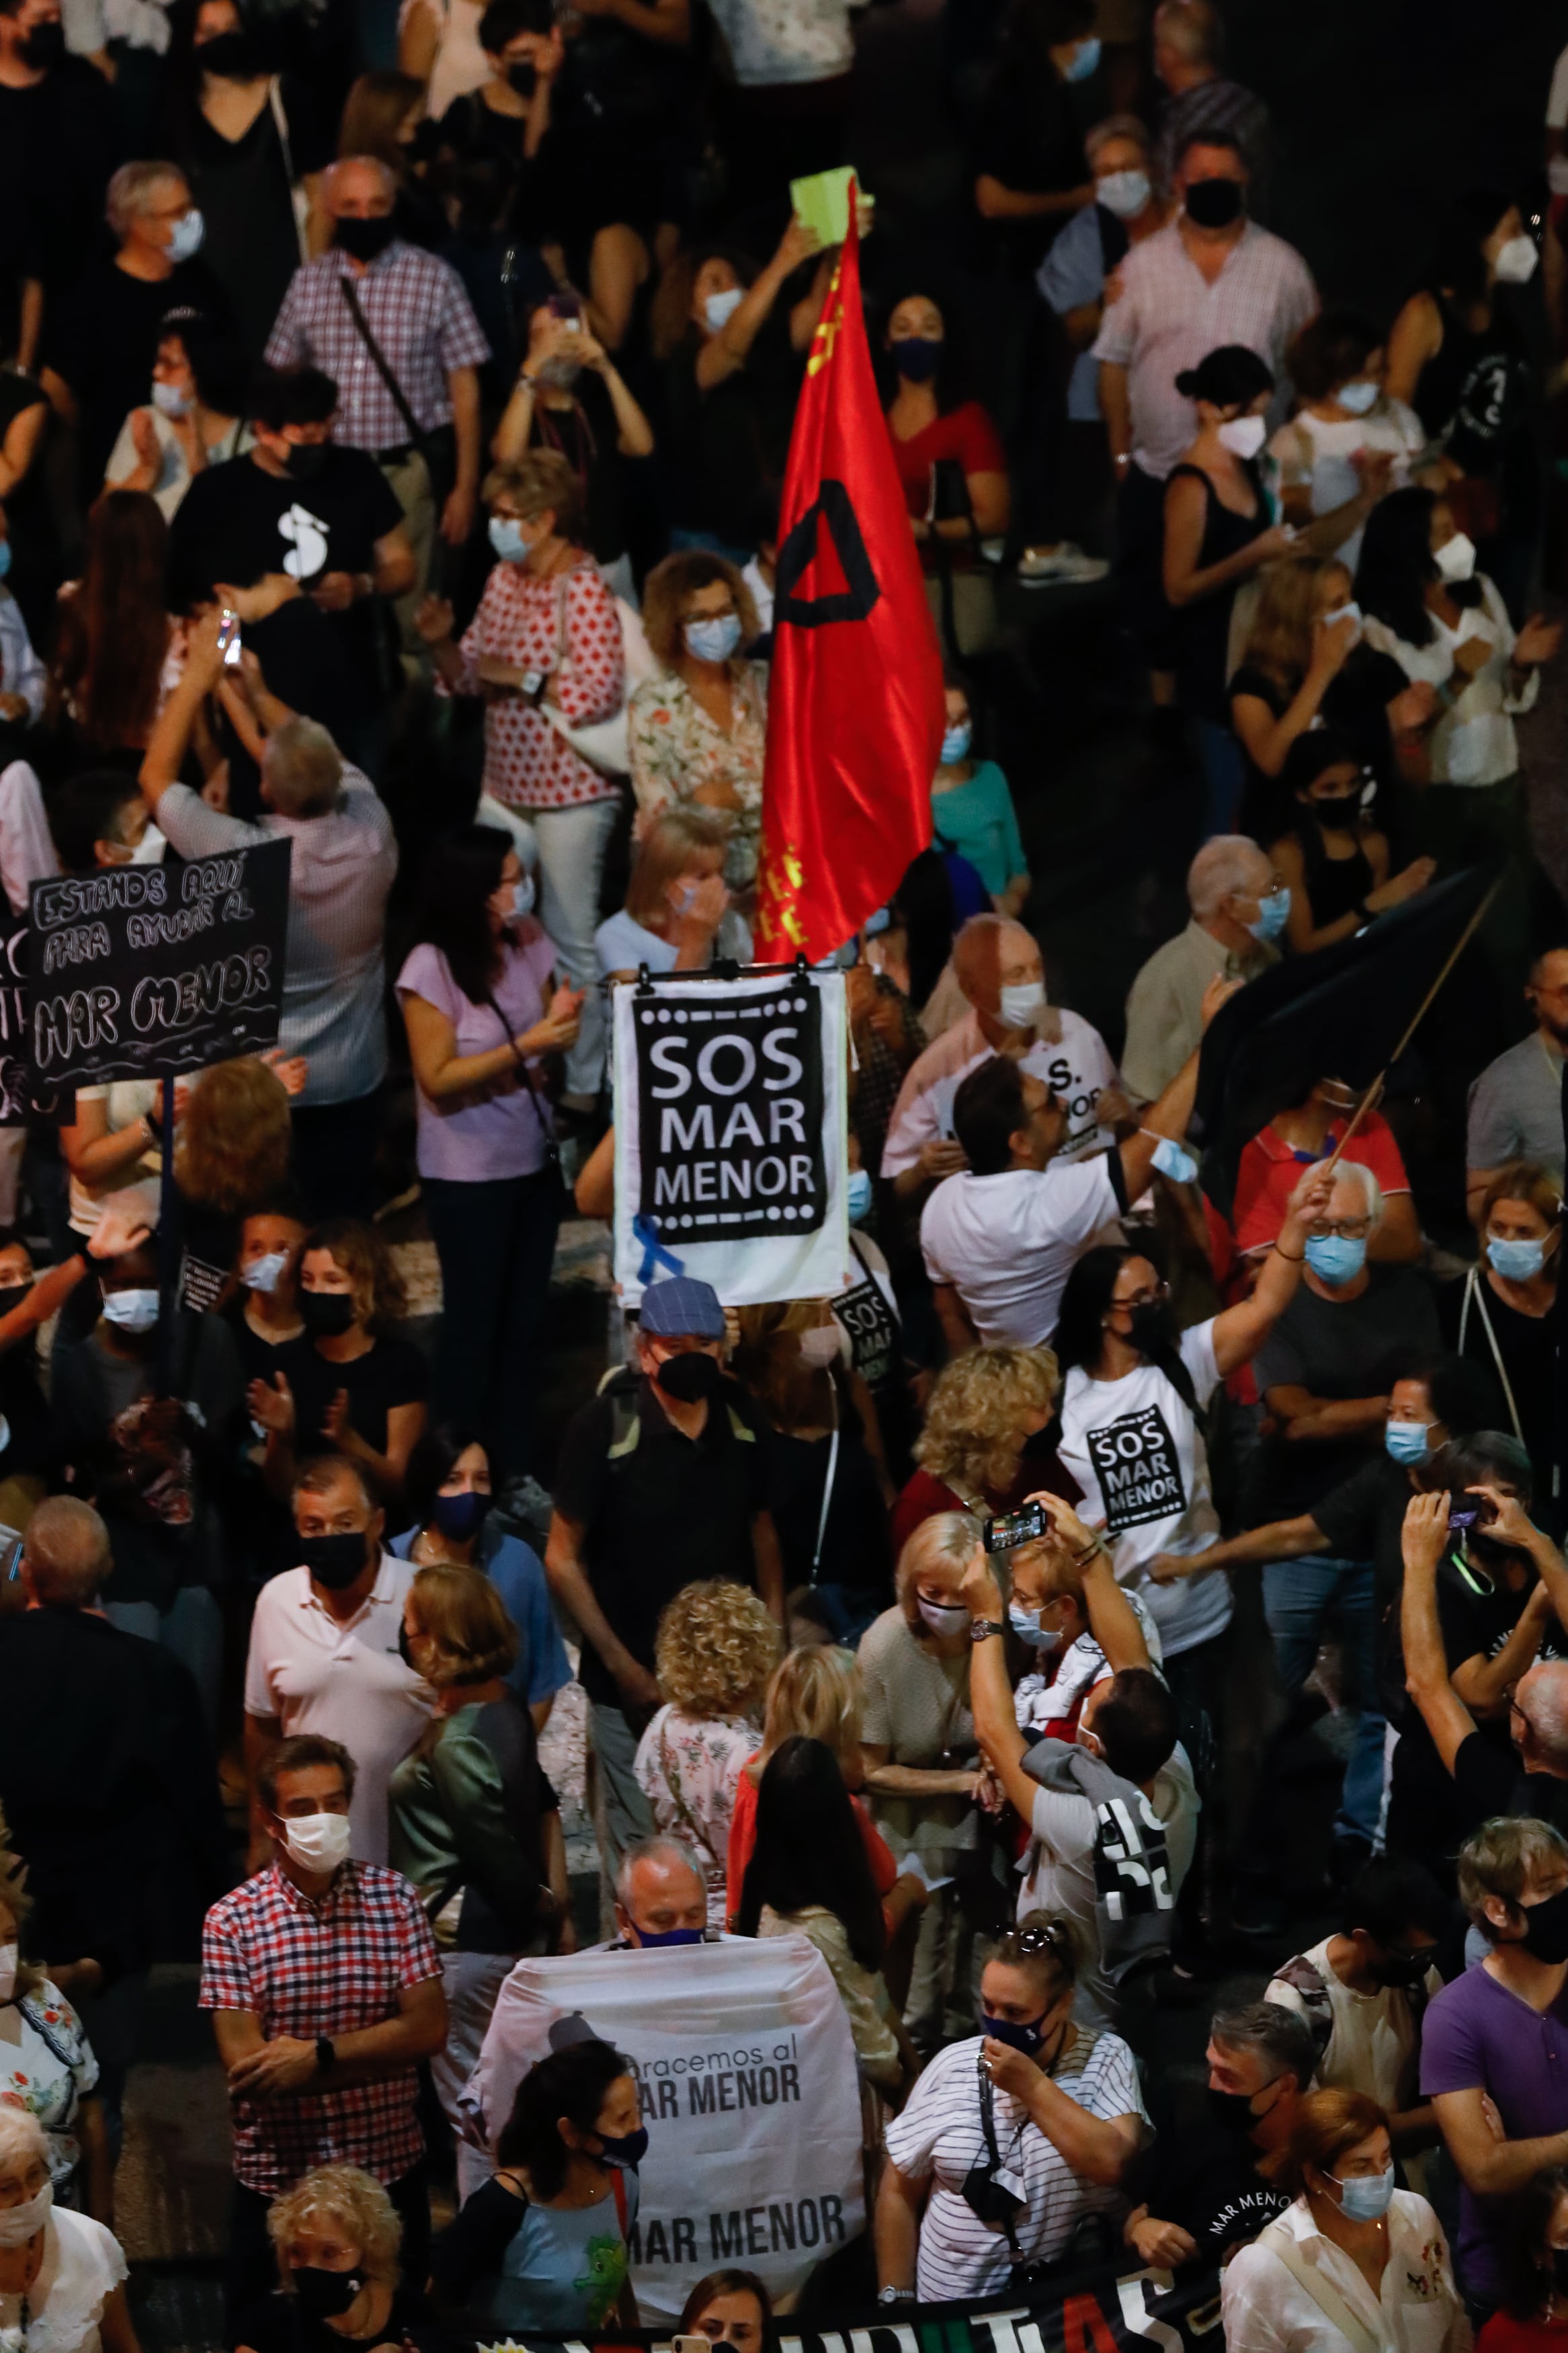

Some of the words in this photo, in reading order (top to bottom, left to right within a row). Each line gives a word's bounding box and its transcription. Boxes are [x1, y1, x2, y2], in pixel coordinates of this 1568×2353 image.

[44, 921, 111, 975] PARA
[126, 898, 215, 949] AYUDAR
[222, 888, 255, 922] AL
[34, 986, 120, 1069] MAR
[130, 945, 271, 1031] MENOR
[649, 1027, 803, 1099] SOS
[660, 1098, 807, 1153] MAR
[653, 1154, 816, 1205] MENOR
[1095, 1421, 1165, 1467] SOS
[1105, 1452, 1171, 1493] MAR
[1109, 1476, 1179, 1513] MENOR
[773, 2033, 798, 2061] al
[636, 2079, 679, 2120] AR
[689, 2063, 801, 2116] MENOR
[710, 2194, 845, 2260] MENOR
[1208, 2204, 1239, 2235] MAR
[1239, 2192, 1292, 2210] MENO
